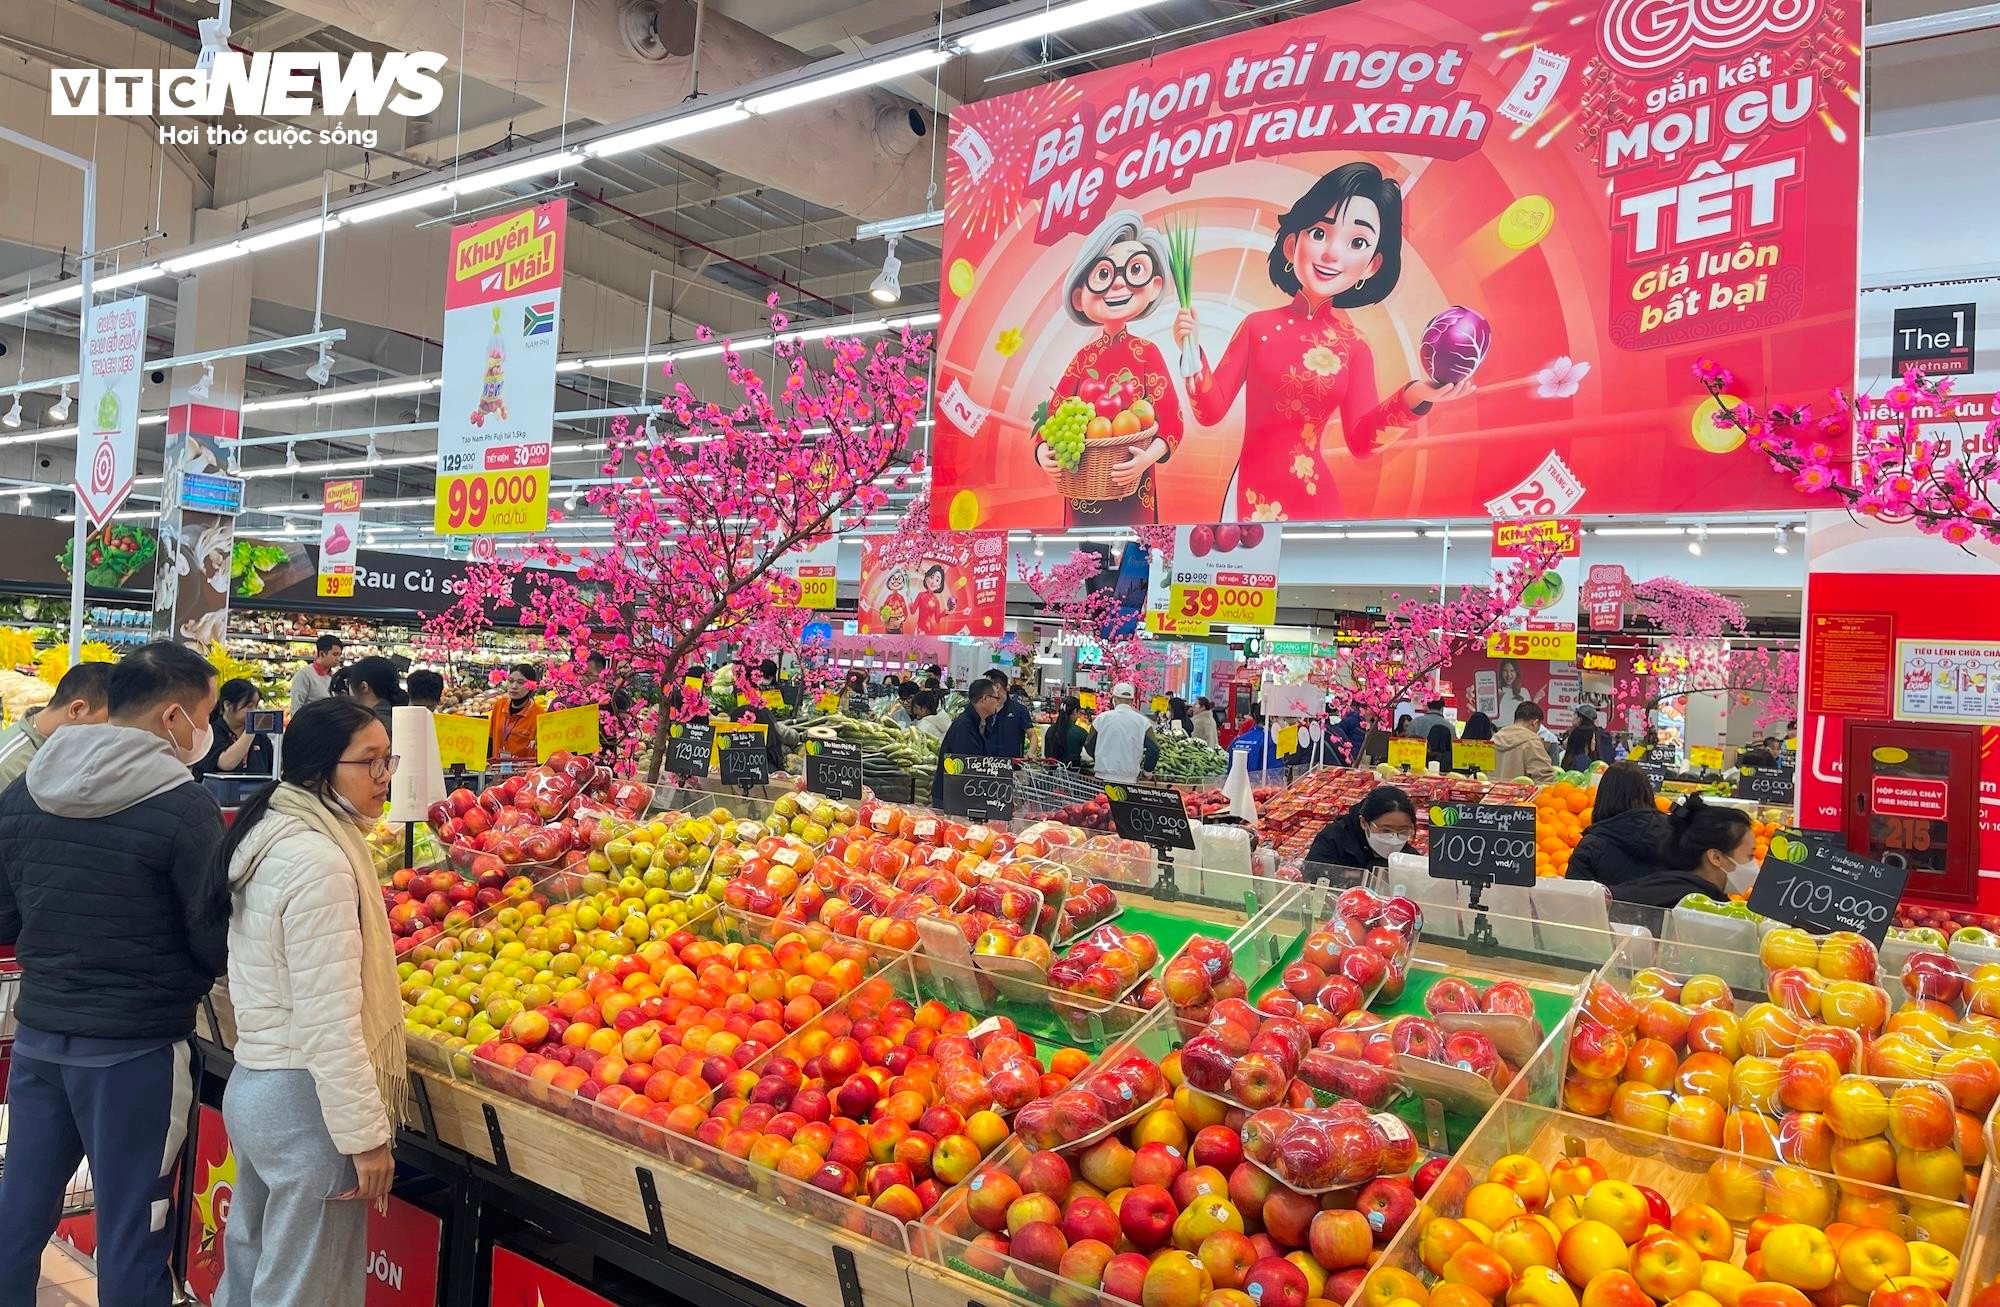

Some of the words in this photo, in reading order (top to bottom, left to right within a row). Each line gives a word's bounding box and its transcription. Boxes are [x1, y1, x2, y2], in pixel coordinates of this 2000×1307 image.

[1523, 74, 1548, 101] 3
[1646, 71, 1708, 113] gắn
[1718, 52, 1772, 90] kết
[1028, 113, 1085, 186] Bà
[1226, 42, 1319, 98] trái
[1323, 48, 1463, 93] ngọt
[1605, 105, 1711, 168] MỌI
[1724, 75, 1813, 134] GU
[1040, 165, 1104, 233] Mẹ
[1116, 116, 1235, 190] chọn
[1243, 110, 1330, 149] rau
[1342, 97, 1487, 143] xanh
[1620, 143, 1796, 253] TẾT
[459, 221, 529, 271] Khuyến
[1631, 256, 1690, 301] Giá
[1697, 241, 1779, 279] luôn
[1639, 287, 1701, 333] bất
[1708, 273, 1768, 312] bại
[1904, 360, 1963, 372] Vietnam
[955, 402, 972, 421] 2
[447, 474, 537, 529] 99.000
[492, 509, 528, 526] vnd/túi
[354, 566, 396, 590] Rau
[404, 569, 435, 594] Củ
[1180, 586, 1264, 618] 39.000
[1222, 608, 1255, 621] vnd/kg
[1593, 598, 1618, 613] TẾT
[818, 763, 861, 784] 55.000
[1130, 807, 1188, 833] 69.000
[1877, 797, 1896, 805] FIRE
[1896, 798, 1920, 807] HOSE
[1920, 801, 1942, 809] REEL
[1432, 833, 1536, 867] 109.000
[1886, 817, 1931, 851] 215
[1775, 875, 1889, 924] 109.000
